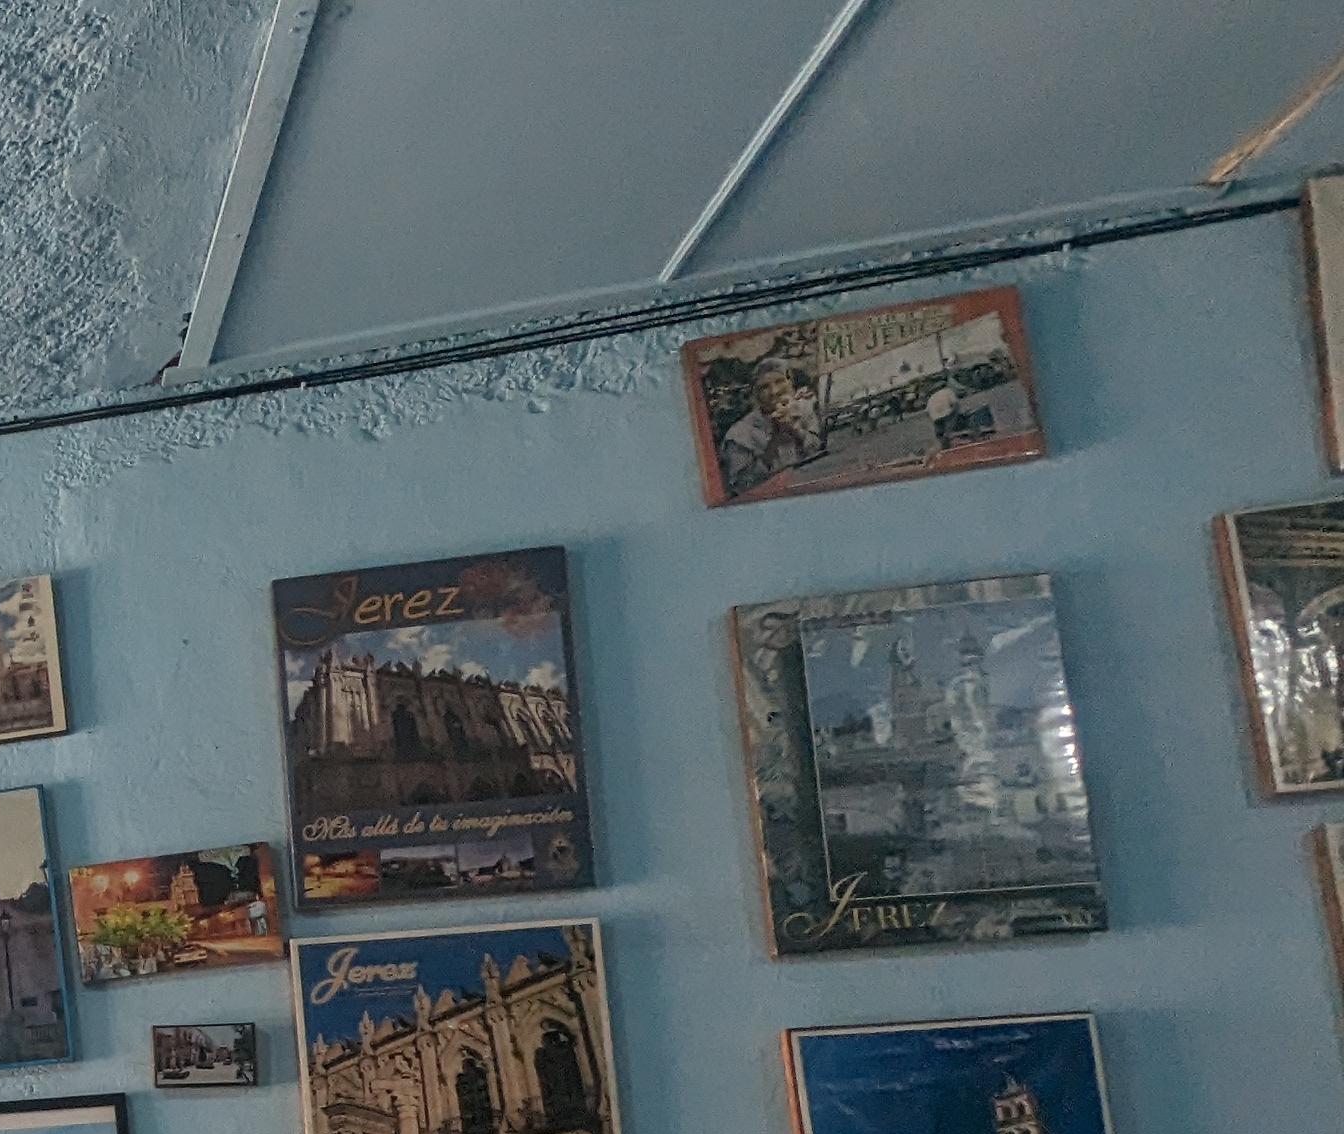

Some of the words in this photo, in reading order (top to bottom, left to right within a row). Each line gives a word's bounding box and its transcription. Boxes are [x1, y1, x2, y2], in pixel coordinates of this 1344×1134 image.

[278, 574, 464, 646] Jerez
[402, 811, 425, 834] de
[310, 947, 418, 1005] Jerez
